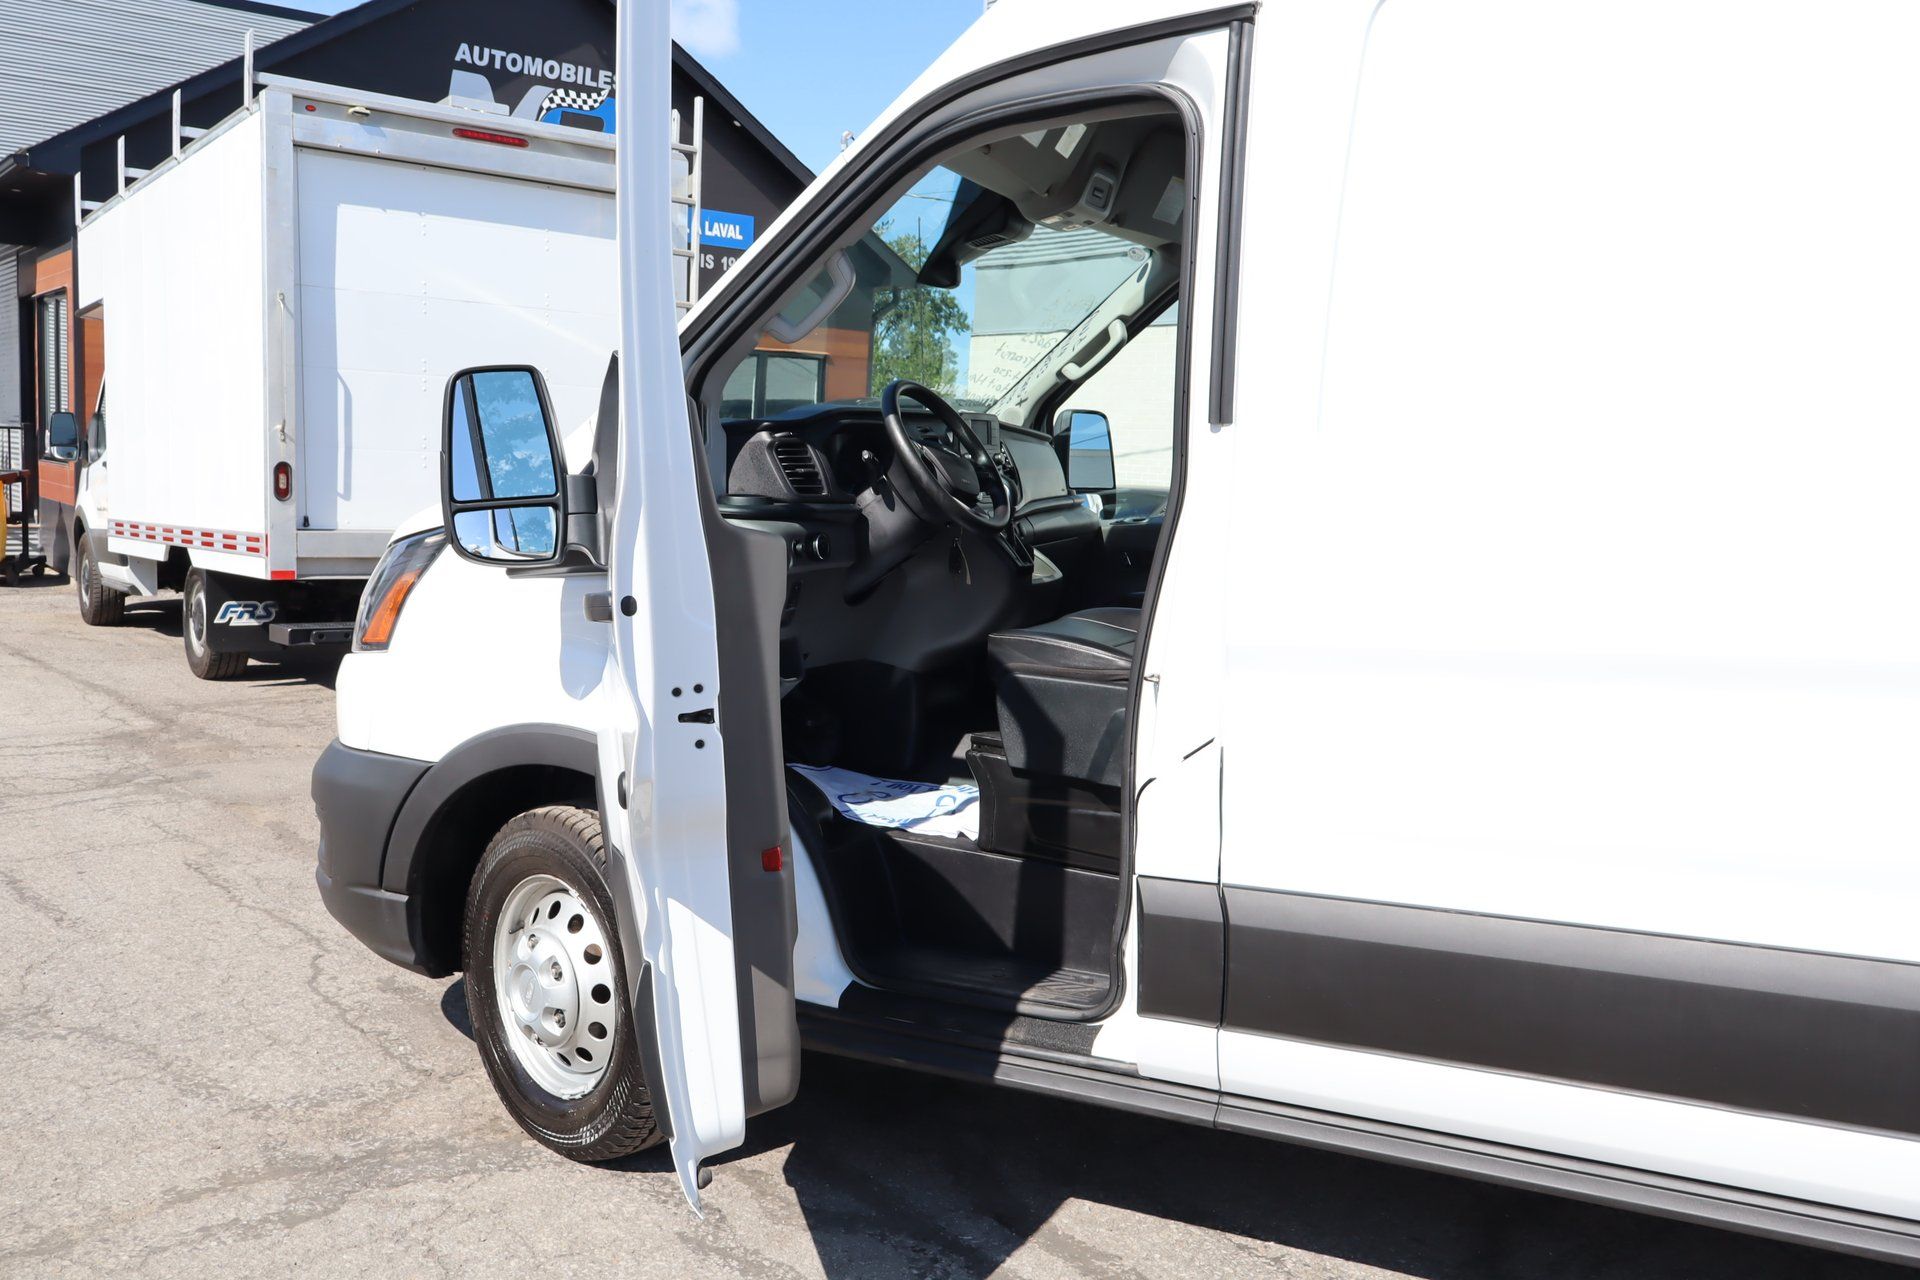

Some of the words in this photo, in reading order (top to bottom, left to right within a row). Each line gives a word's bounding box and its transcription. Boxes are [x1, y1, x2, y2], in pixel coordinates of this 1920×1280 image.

[455, 42, 616, 91] AUTOMOBILE
[704, 221, 744, 241] LAVAL
[213, 600, 277, 626] FRS
